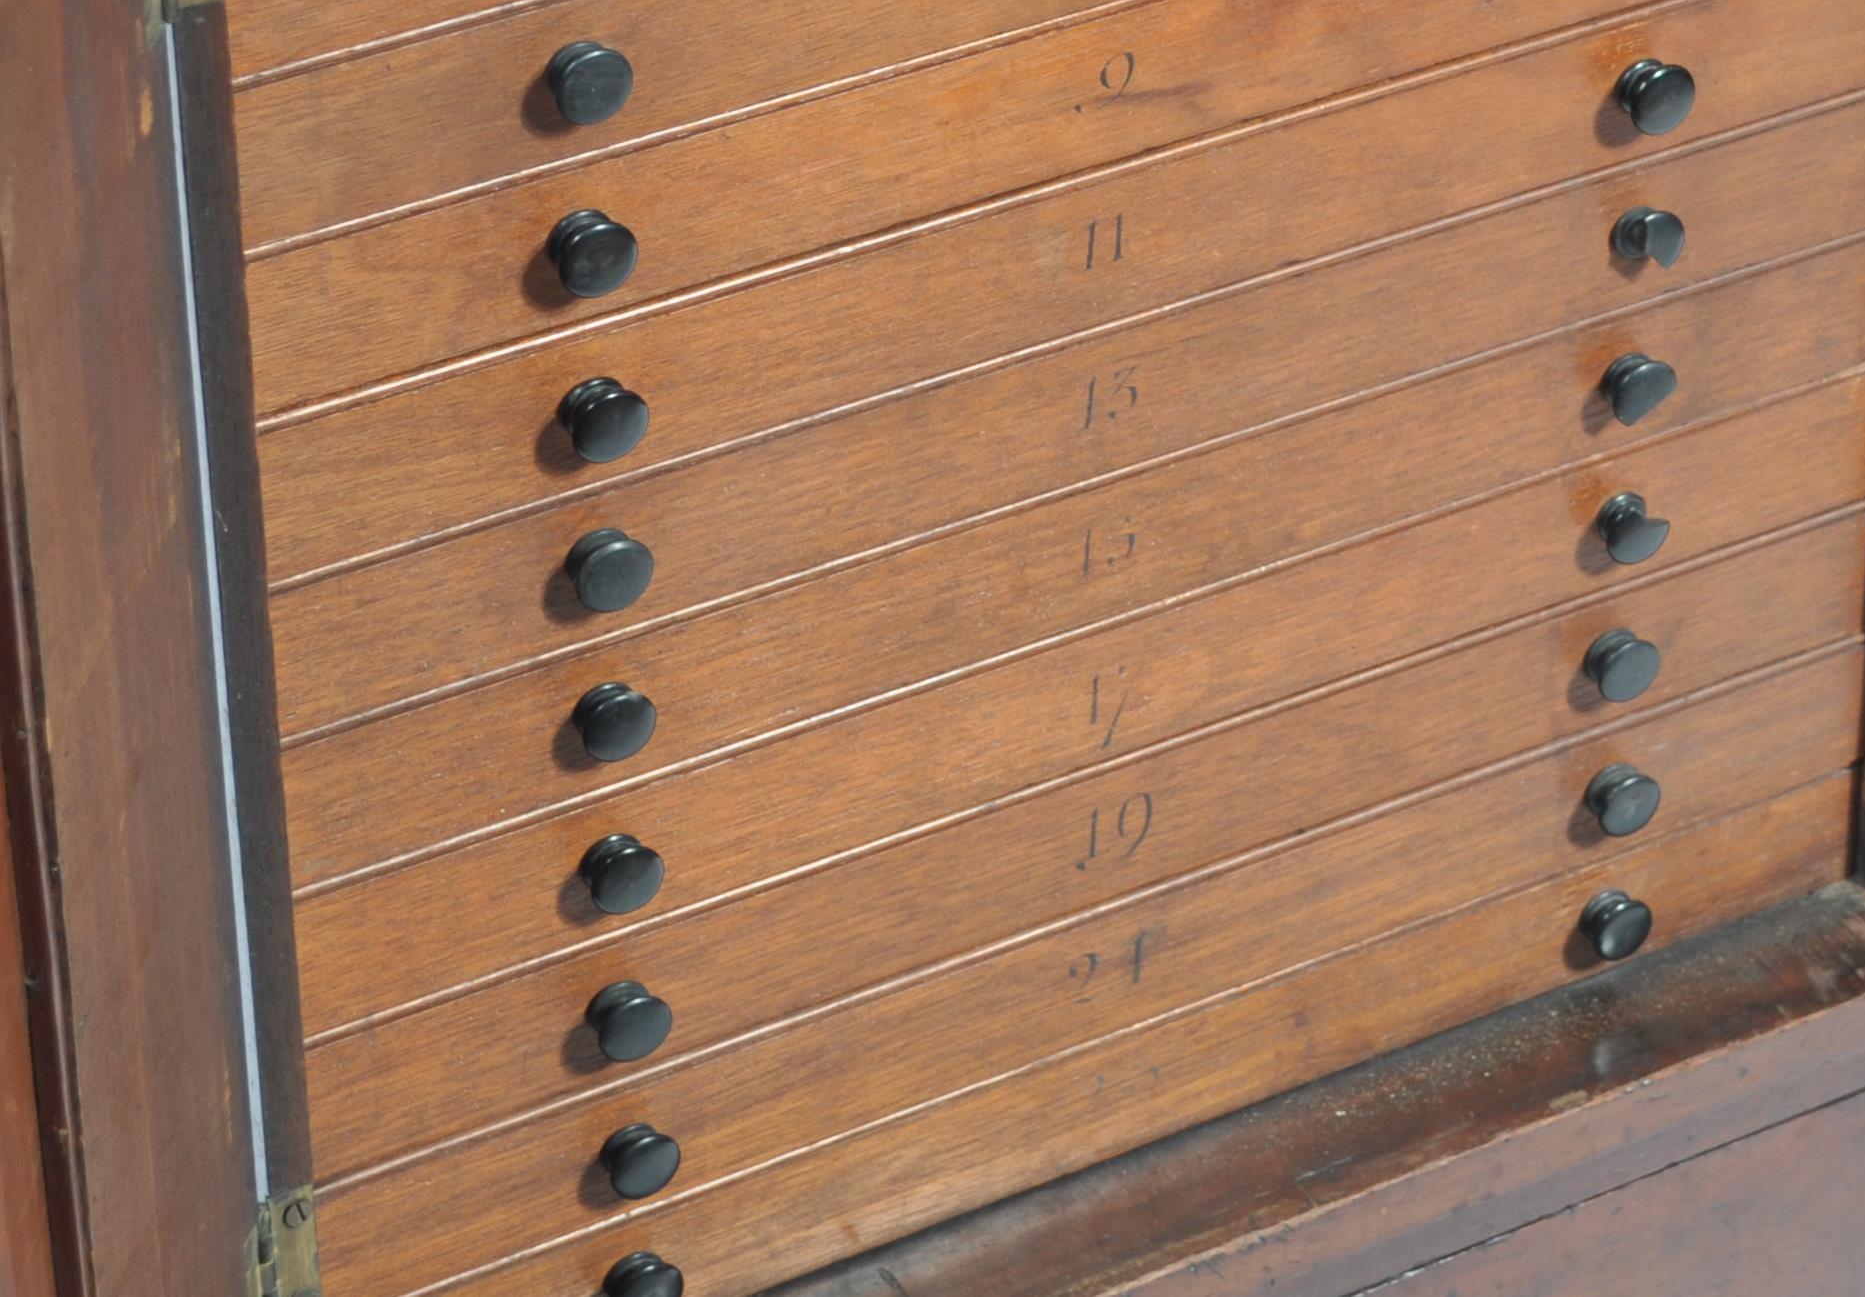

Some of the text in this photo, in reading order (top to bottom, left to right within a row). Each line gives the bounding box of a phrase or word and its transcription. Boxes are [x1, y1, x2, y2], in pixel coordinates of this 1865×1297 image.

[1076, 50, 1136, 113] 9
[1082, 212, 1127, 271] 11
[1081, 364, 1141, 432] 13
[1074, 790, 1155, 873] 19
